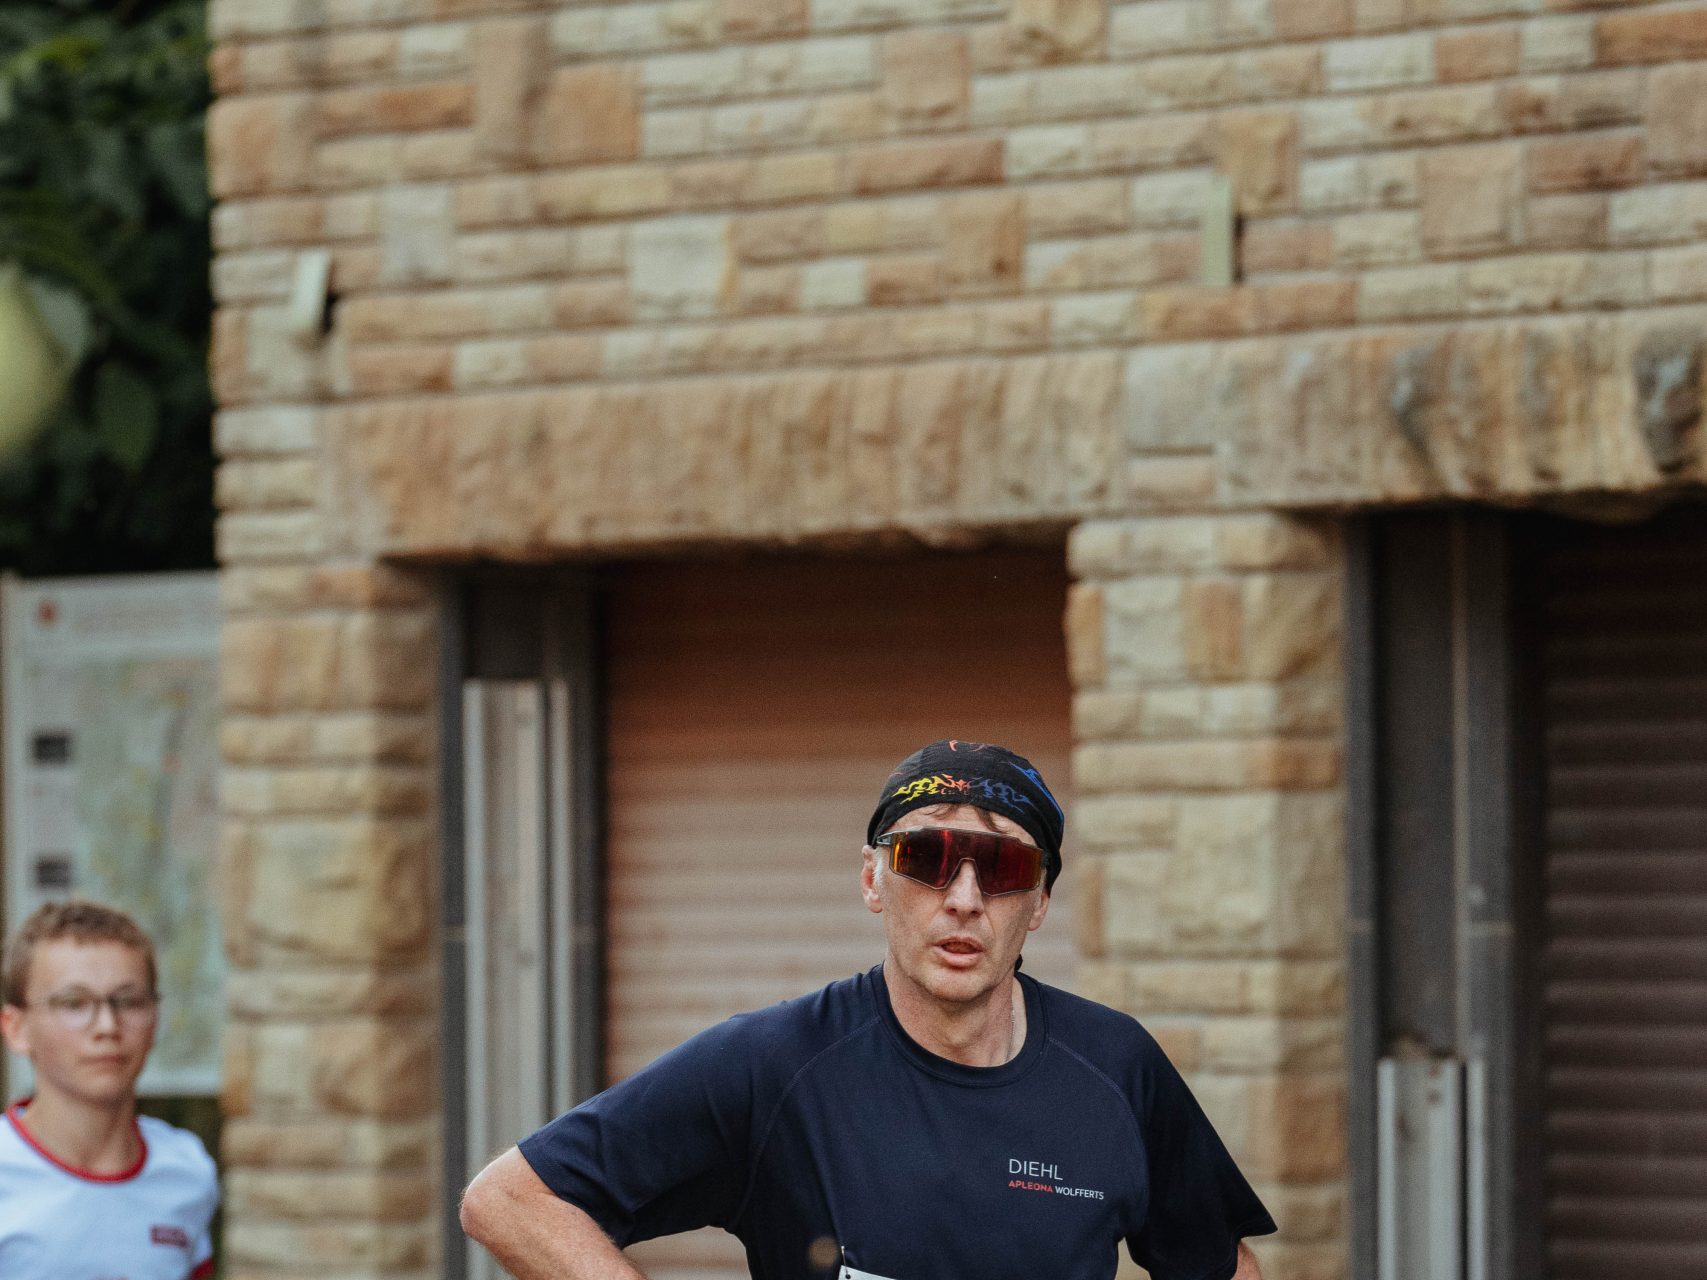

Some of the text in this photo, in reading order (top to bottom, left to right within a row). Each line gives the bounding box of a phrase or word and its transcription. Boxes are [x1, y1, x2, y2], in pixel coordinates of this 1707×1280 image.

[1009, 1158, 1063, 1180] DIEHL
[1008, 1180, 1104, 1200] APLEONA WOLFFERTS
